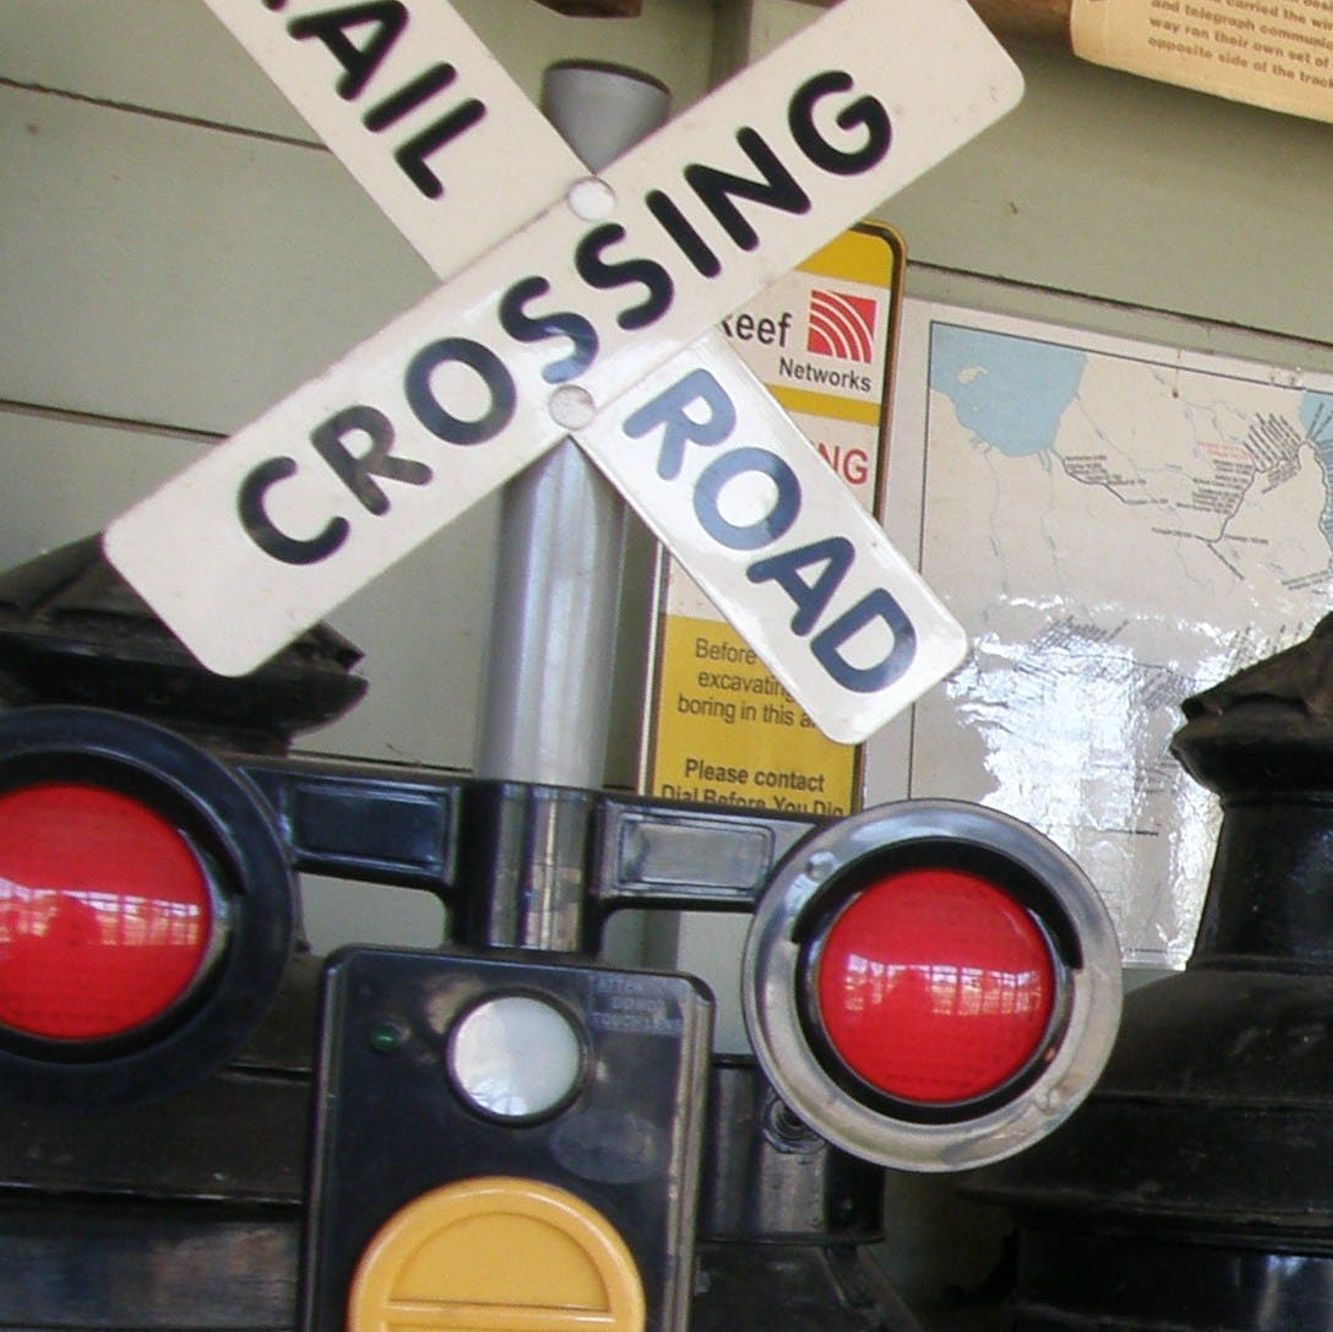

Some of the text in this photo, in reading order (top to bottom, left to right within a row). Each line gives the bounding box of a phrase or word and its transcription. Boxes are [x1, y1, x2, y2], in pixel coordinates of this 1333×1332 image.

[1184, 5, 1256, 33] telegraph
[1283, 9, 1307, 25] the
[1148, 36, 1213, 62] opposite
[1217, 50, 1248, 70] side
[1252, 59, 1269, 74] of
[1272, 63, 1296, 82] the
[1150, 17, 1180, 34] way
[1184, 25, 1210, 39] ran
[1213, 29, 1249, 50] their
[1253, 42, 1285, 57] own
[1289, 49, 1311, 64] set
[1314, 55, 1331, 70] of
[263, 0, 487, 200] AIL
[237, 70, 892, 566] CROSSING
[779, 357, 872, 392] Networks
[624, 367, 917, 694] ROAD
[695, 638, 757, 665] Before
[678, 693, 736, 724] boring
[741, 701, 757, 721] in
[762, 704, 794, 727] this
[685, 758, 826, 793] Please contact
